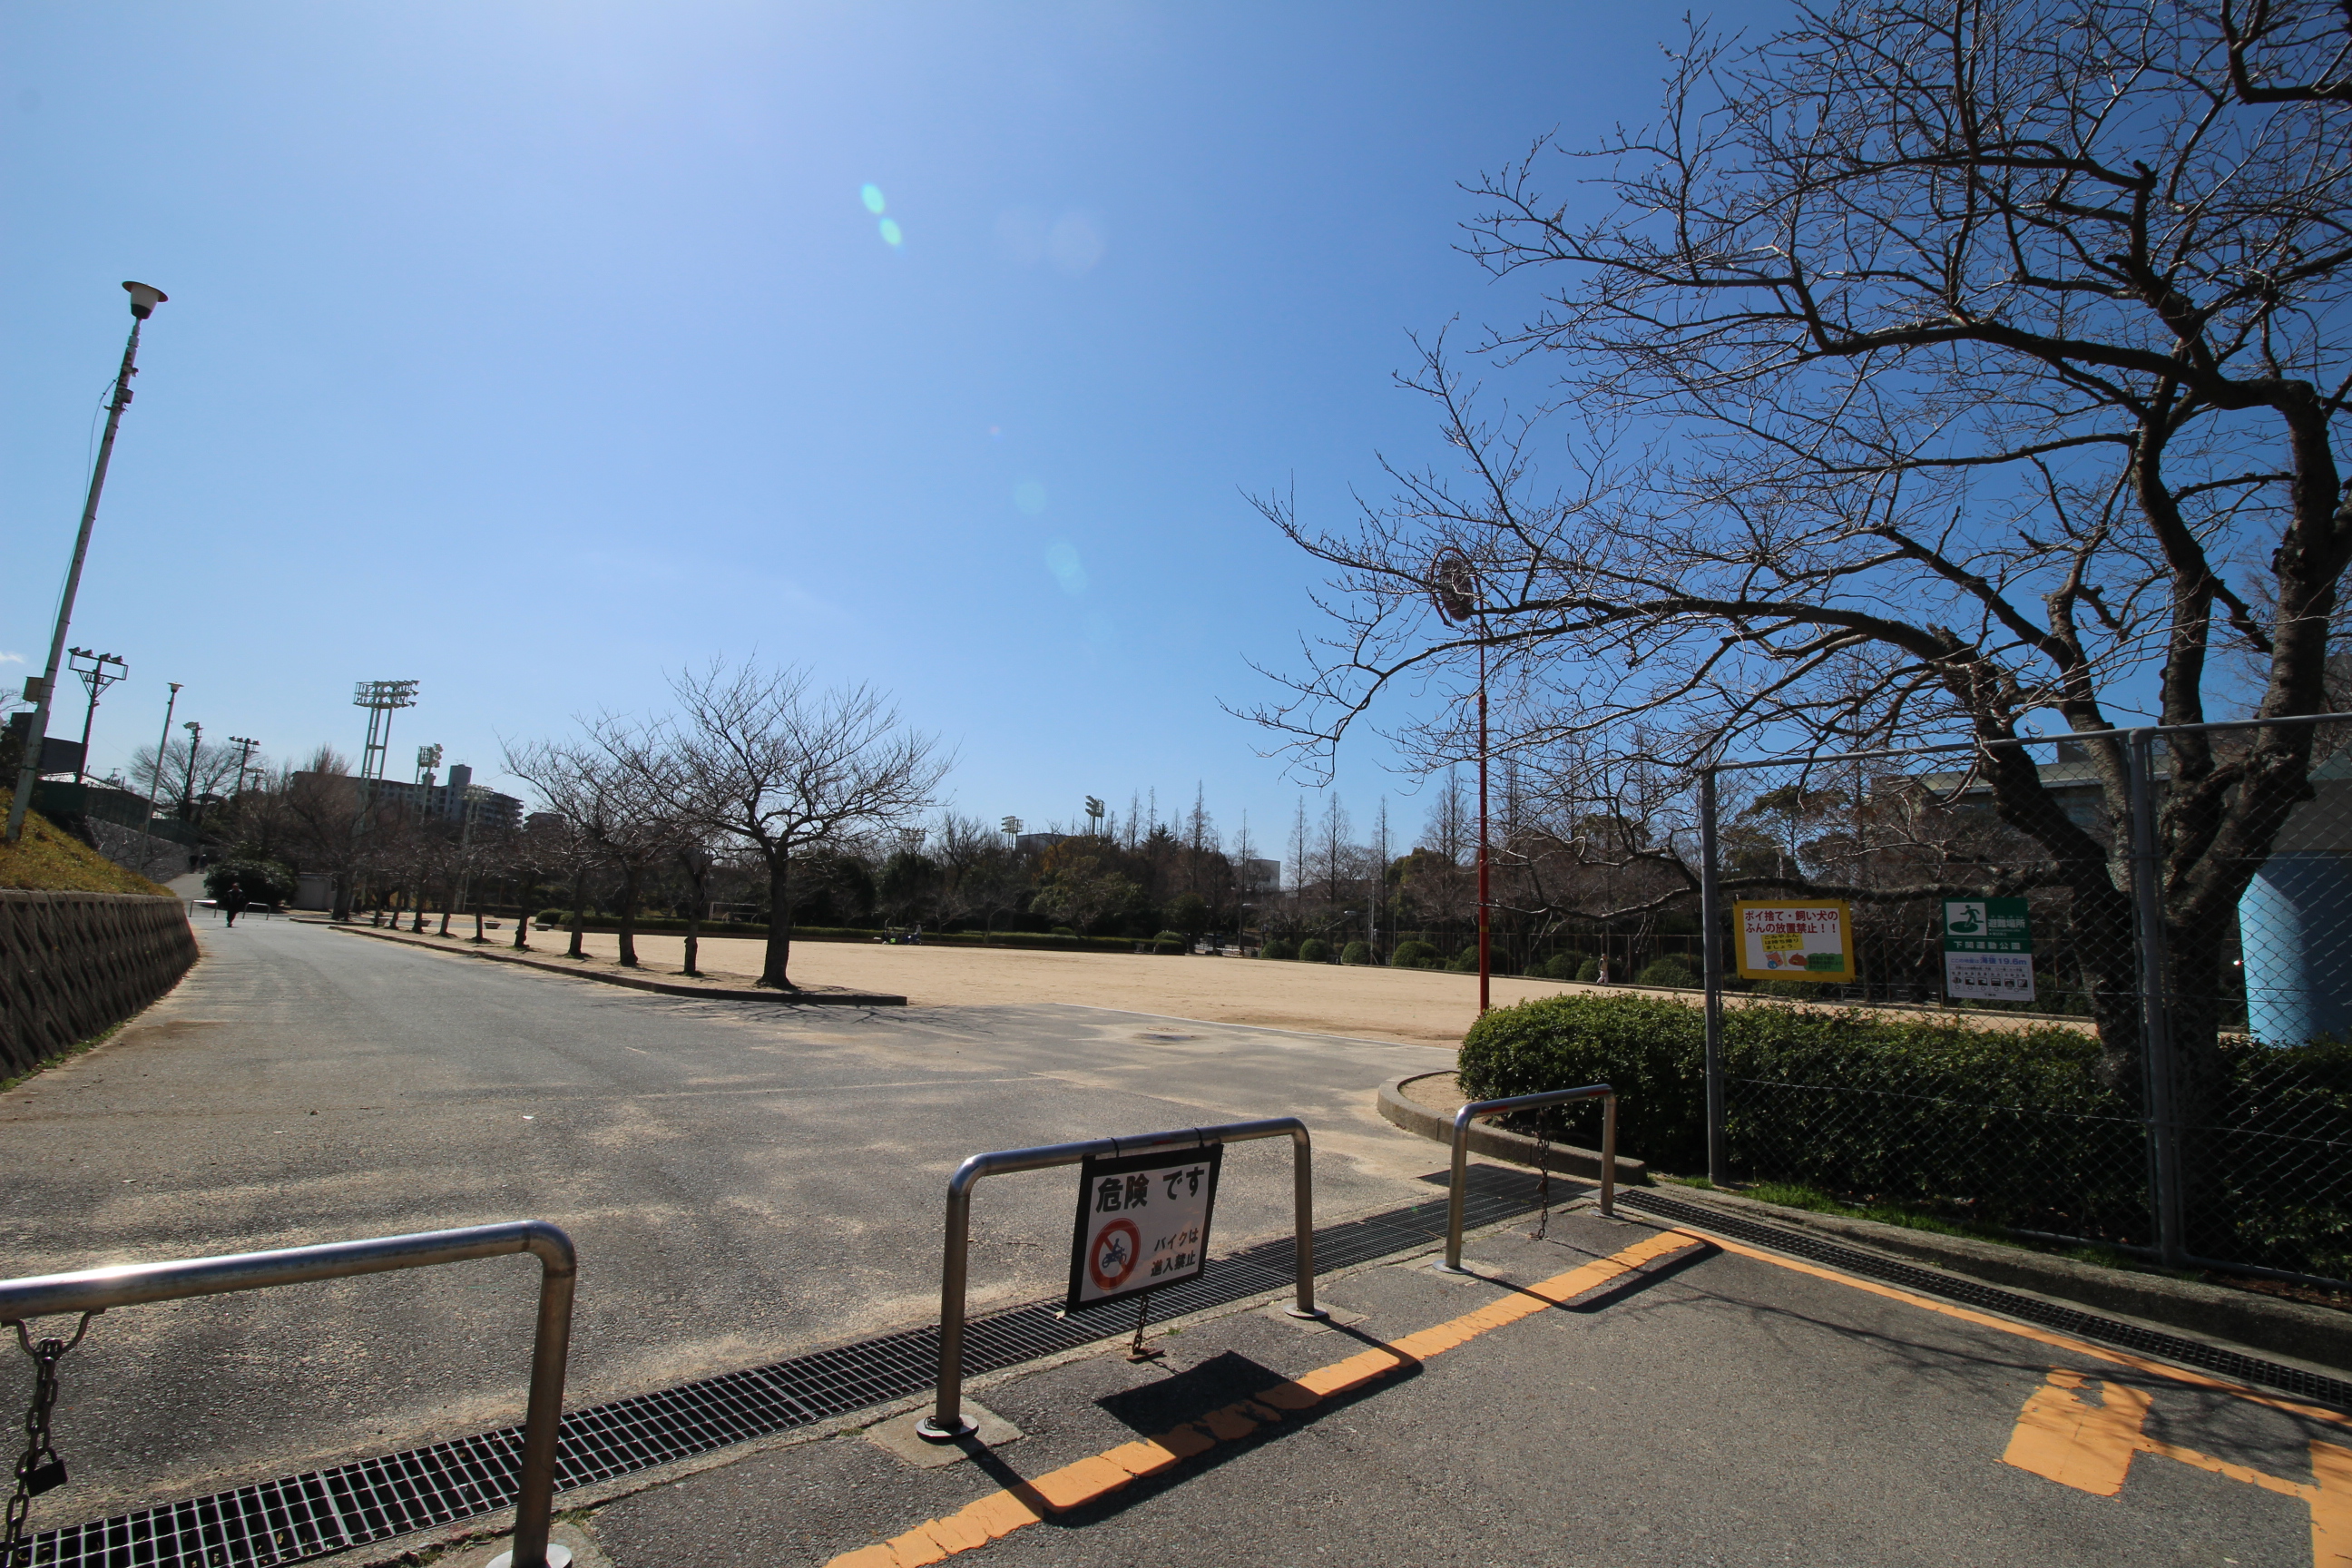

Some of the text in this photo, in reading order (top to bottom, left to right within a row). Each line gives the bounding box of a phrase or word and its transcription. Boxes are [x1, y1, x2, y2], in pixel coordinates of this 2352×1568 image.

[1745, 910, 1838, 921] ポイ捨て・飼い犬の
[1954, 941, 2021, 950] 下関運動公園
[1154, 1228, 1199, 1252] バイクは
[1151, 1250, 1196, 1277] 進入禁止
